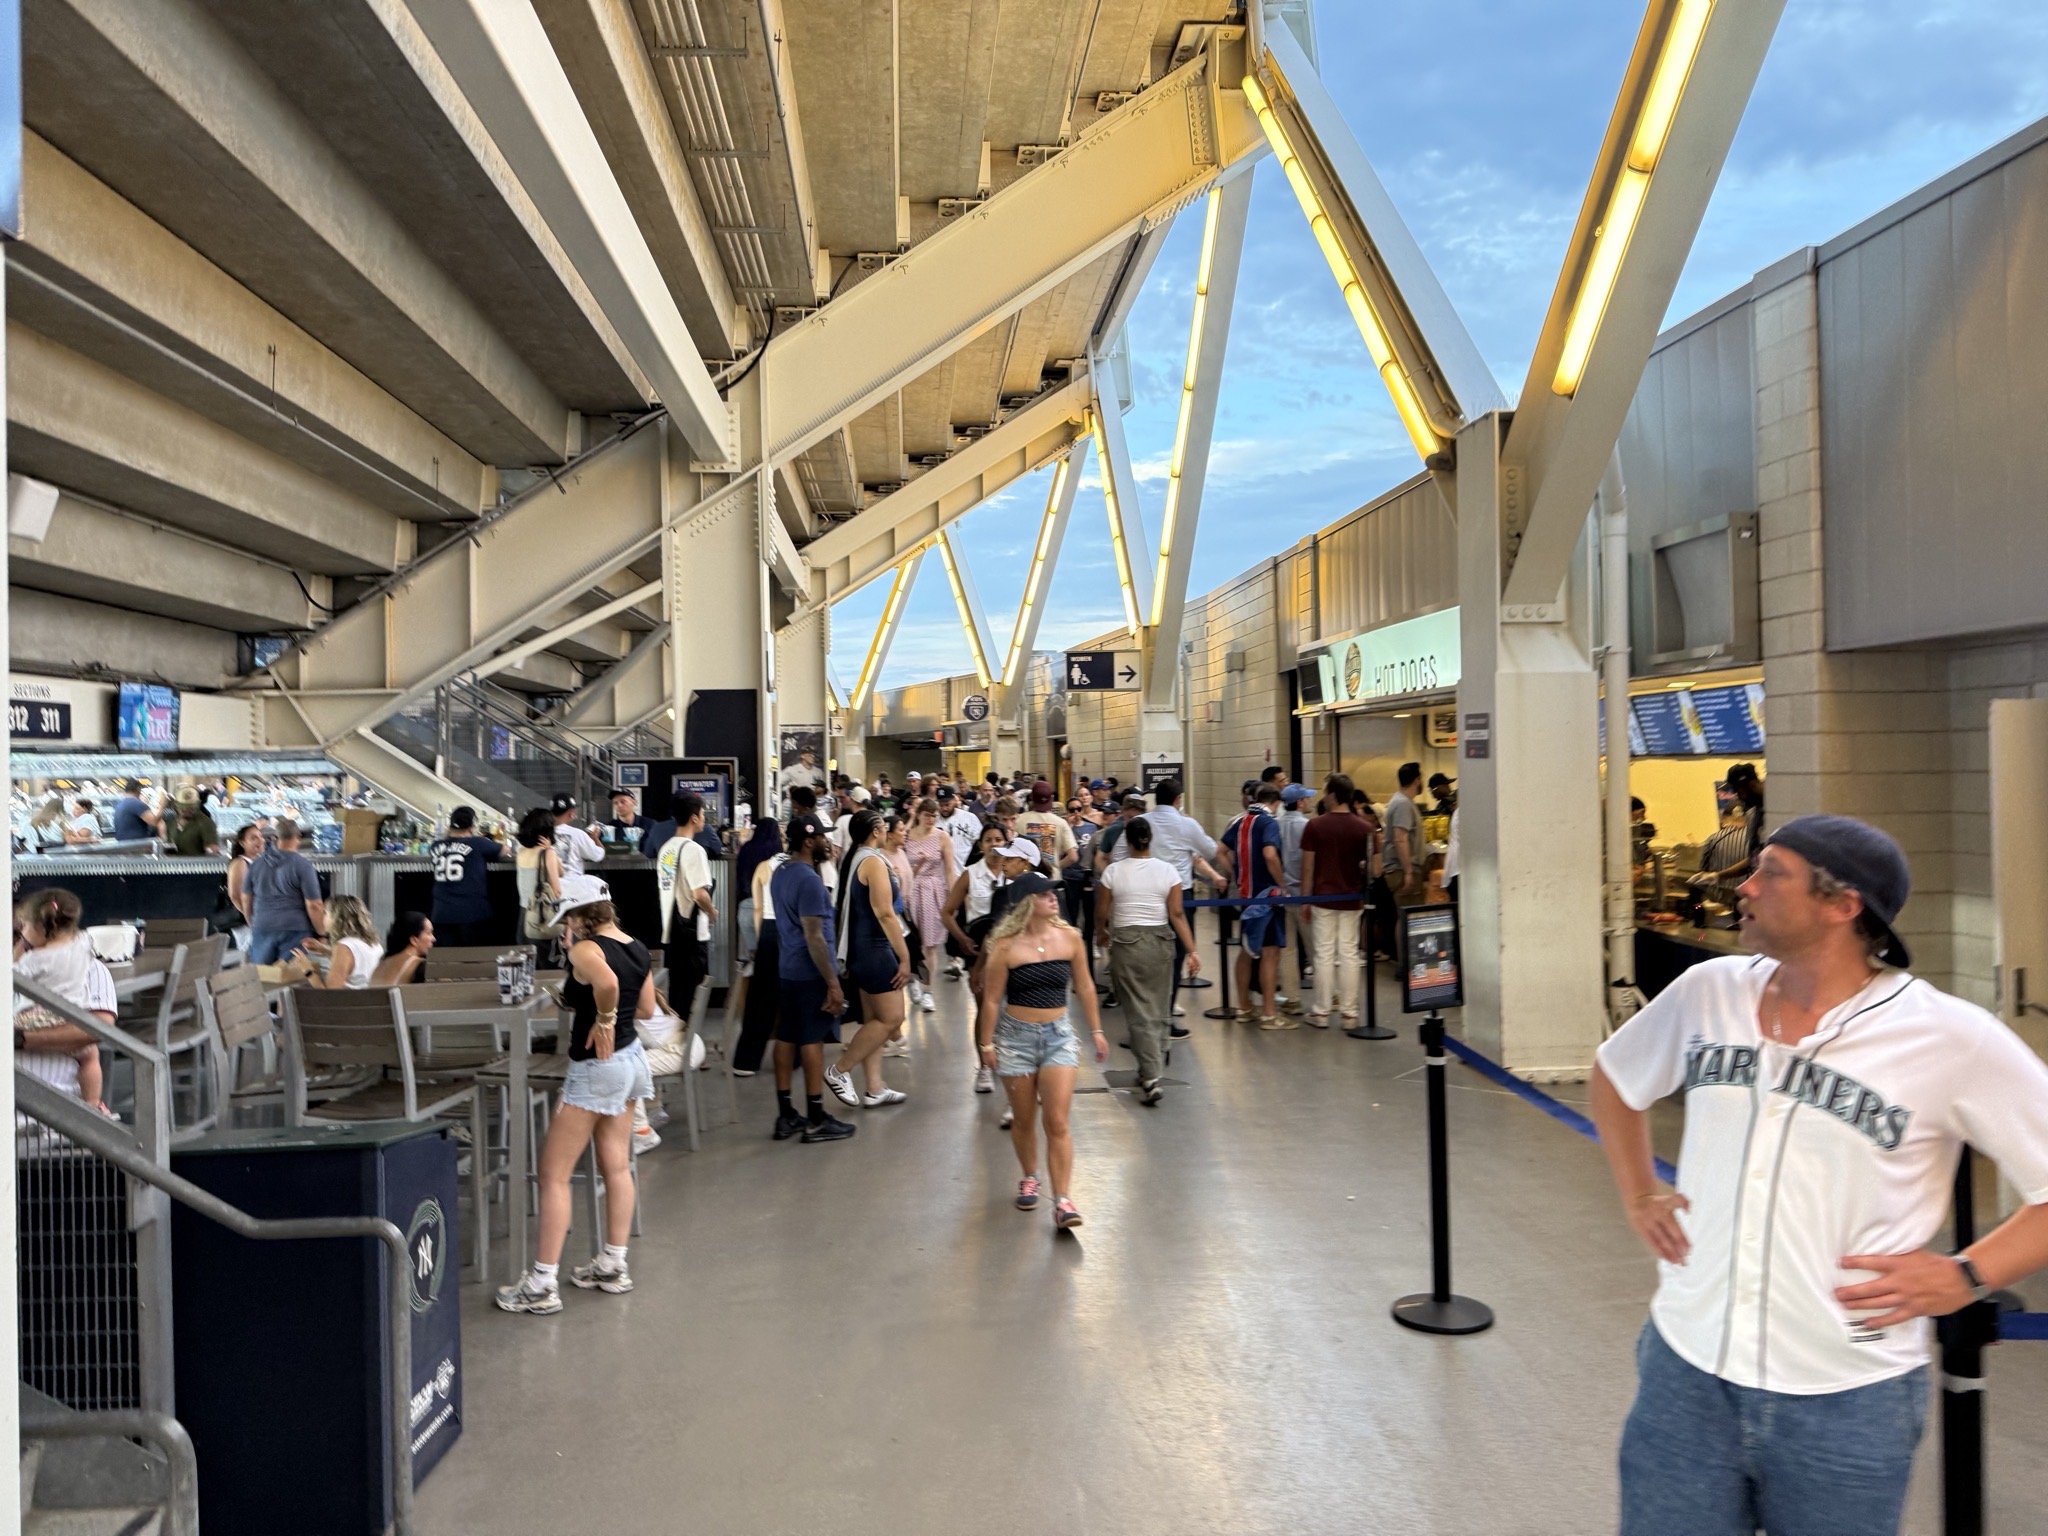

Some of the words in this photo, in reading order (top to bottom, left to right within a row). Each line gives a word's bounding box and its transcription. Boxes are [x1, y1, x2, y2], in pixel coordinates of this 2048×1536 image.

[1375, 663, 1395, 697] HOT
[1400, 654, 1438, 693] DOGS
[14, 683, 51, 699] SECTIONS
[8, 705, 30, 731] 312
[40, 707, 61, 733] 311
[432, 854, 466, 882] 26
